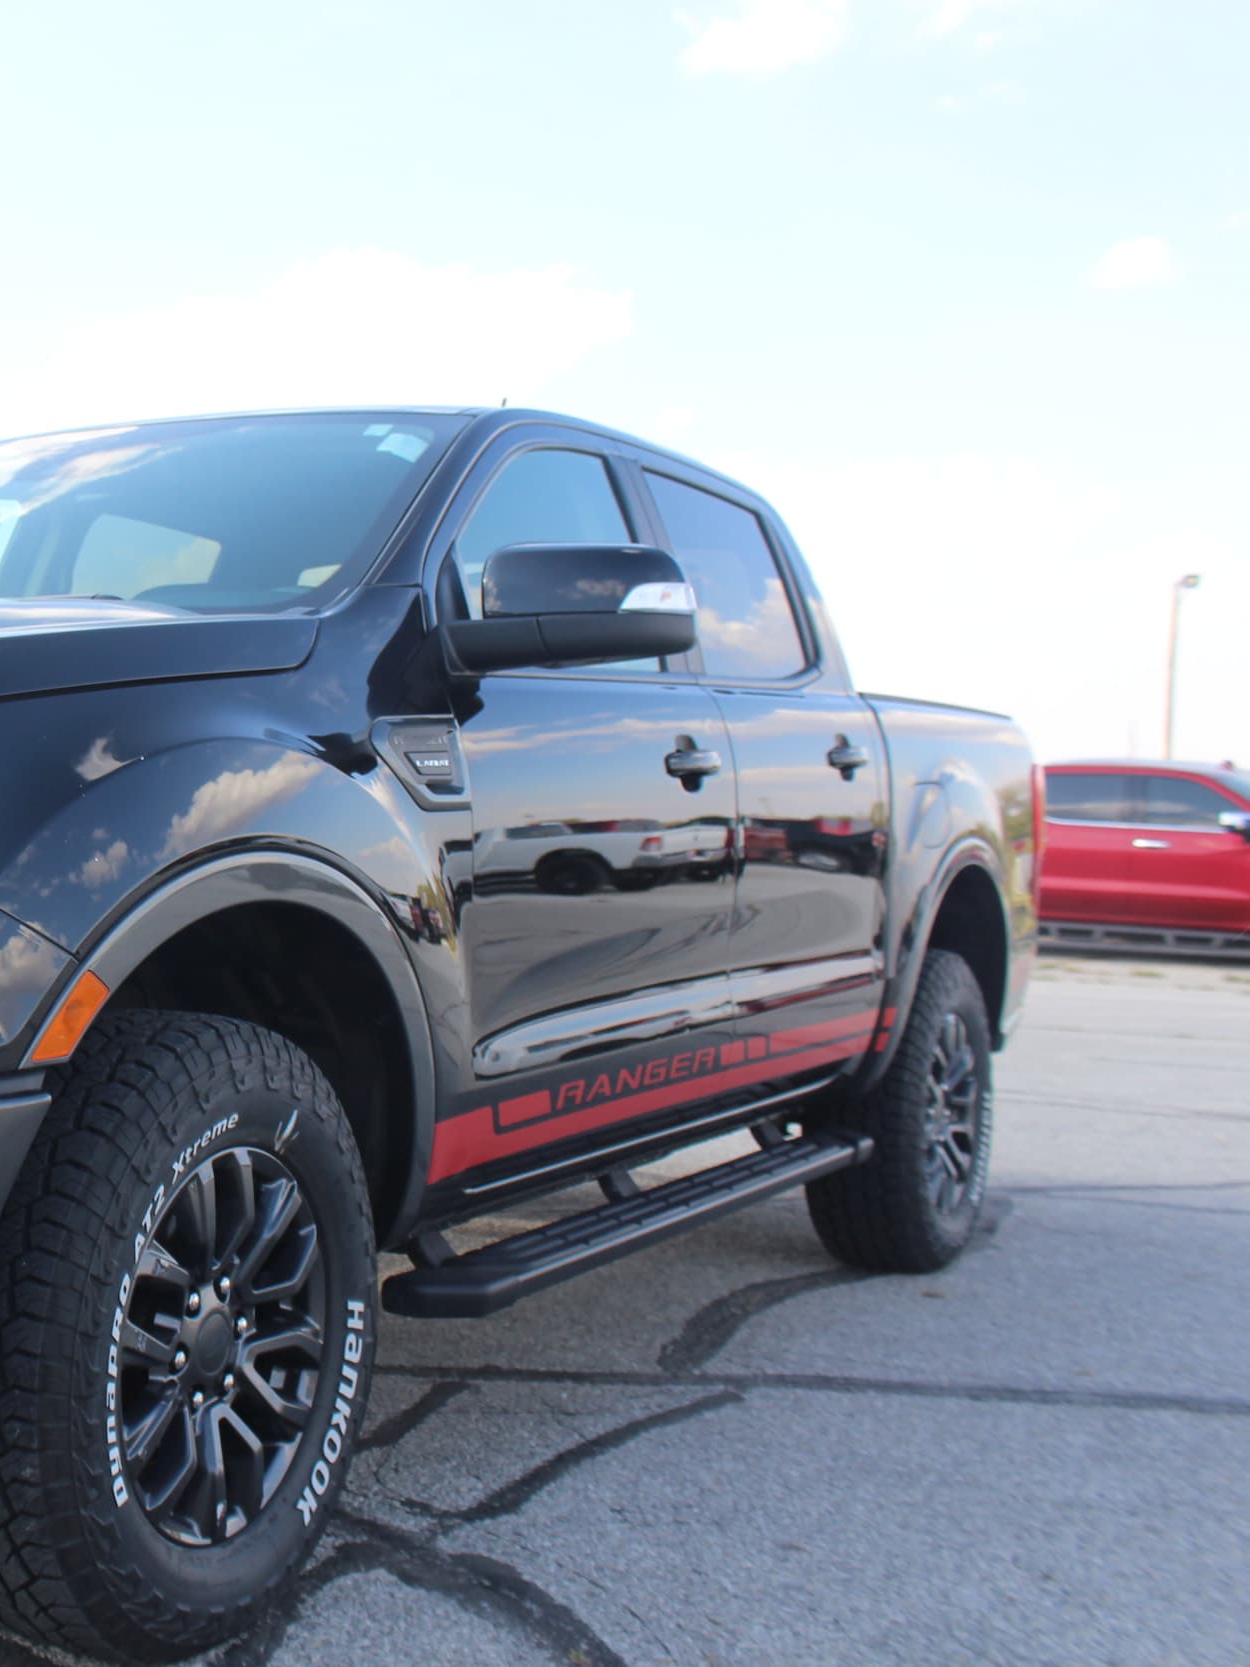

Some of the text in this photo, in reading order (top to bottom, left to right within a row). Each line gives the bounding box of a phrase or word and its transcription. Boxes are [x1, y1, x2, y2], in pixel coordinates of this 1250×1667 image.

[556, 1047, 715, 1110] RANGER
[134, 1183, 165, 1265] AT2
[171, 1111, 239, 1185] Xtreme
